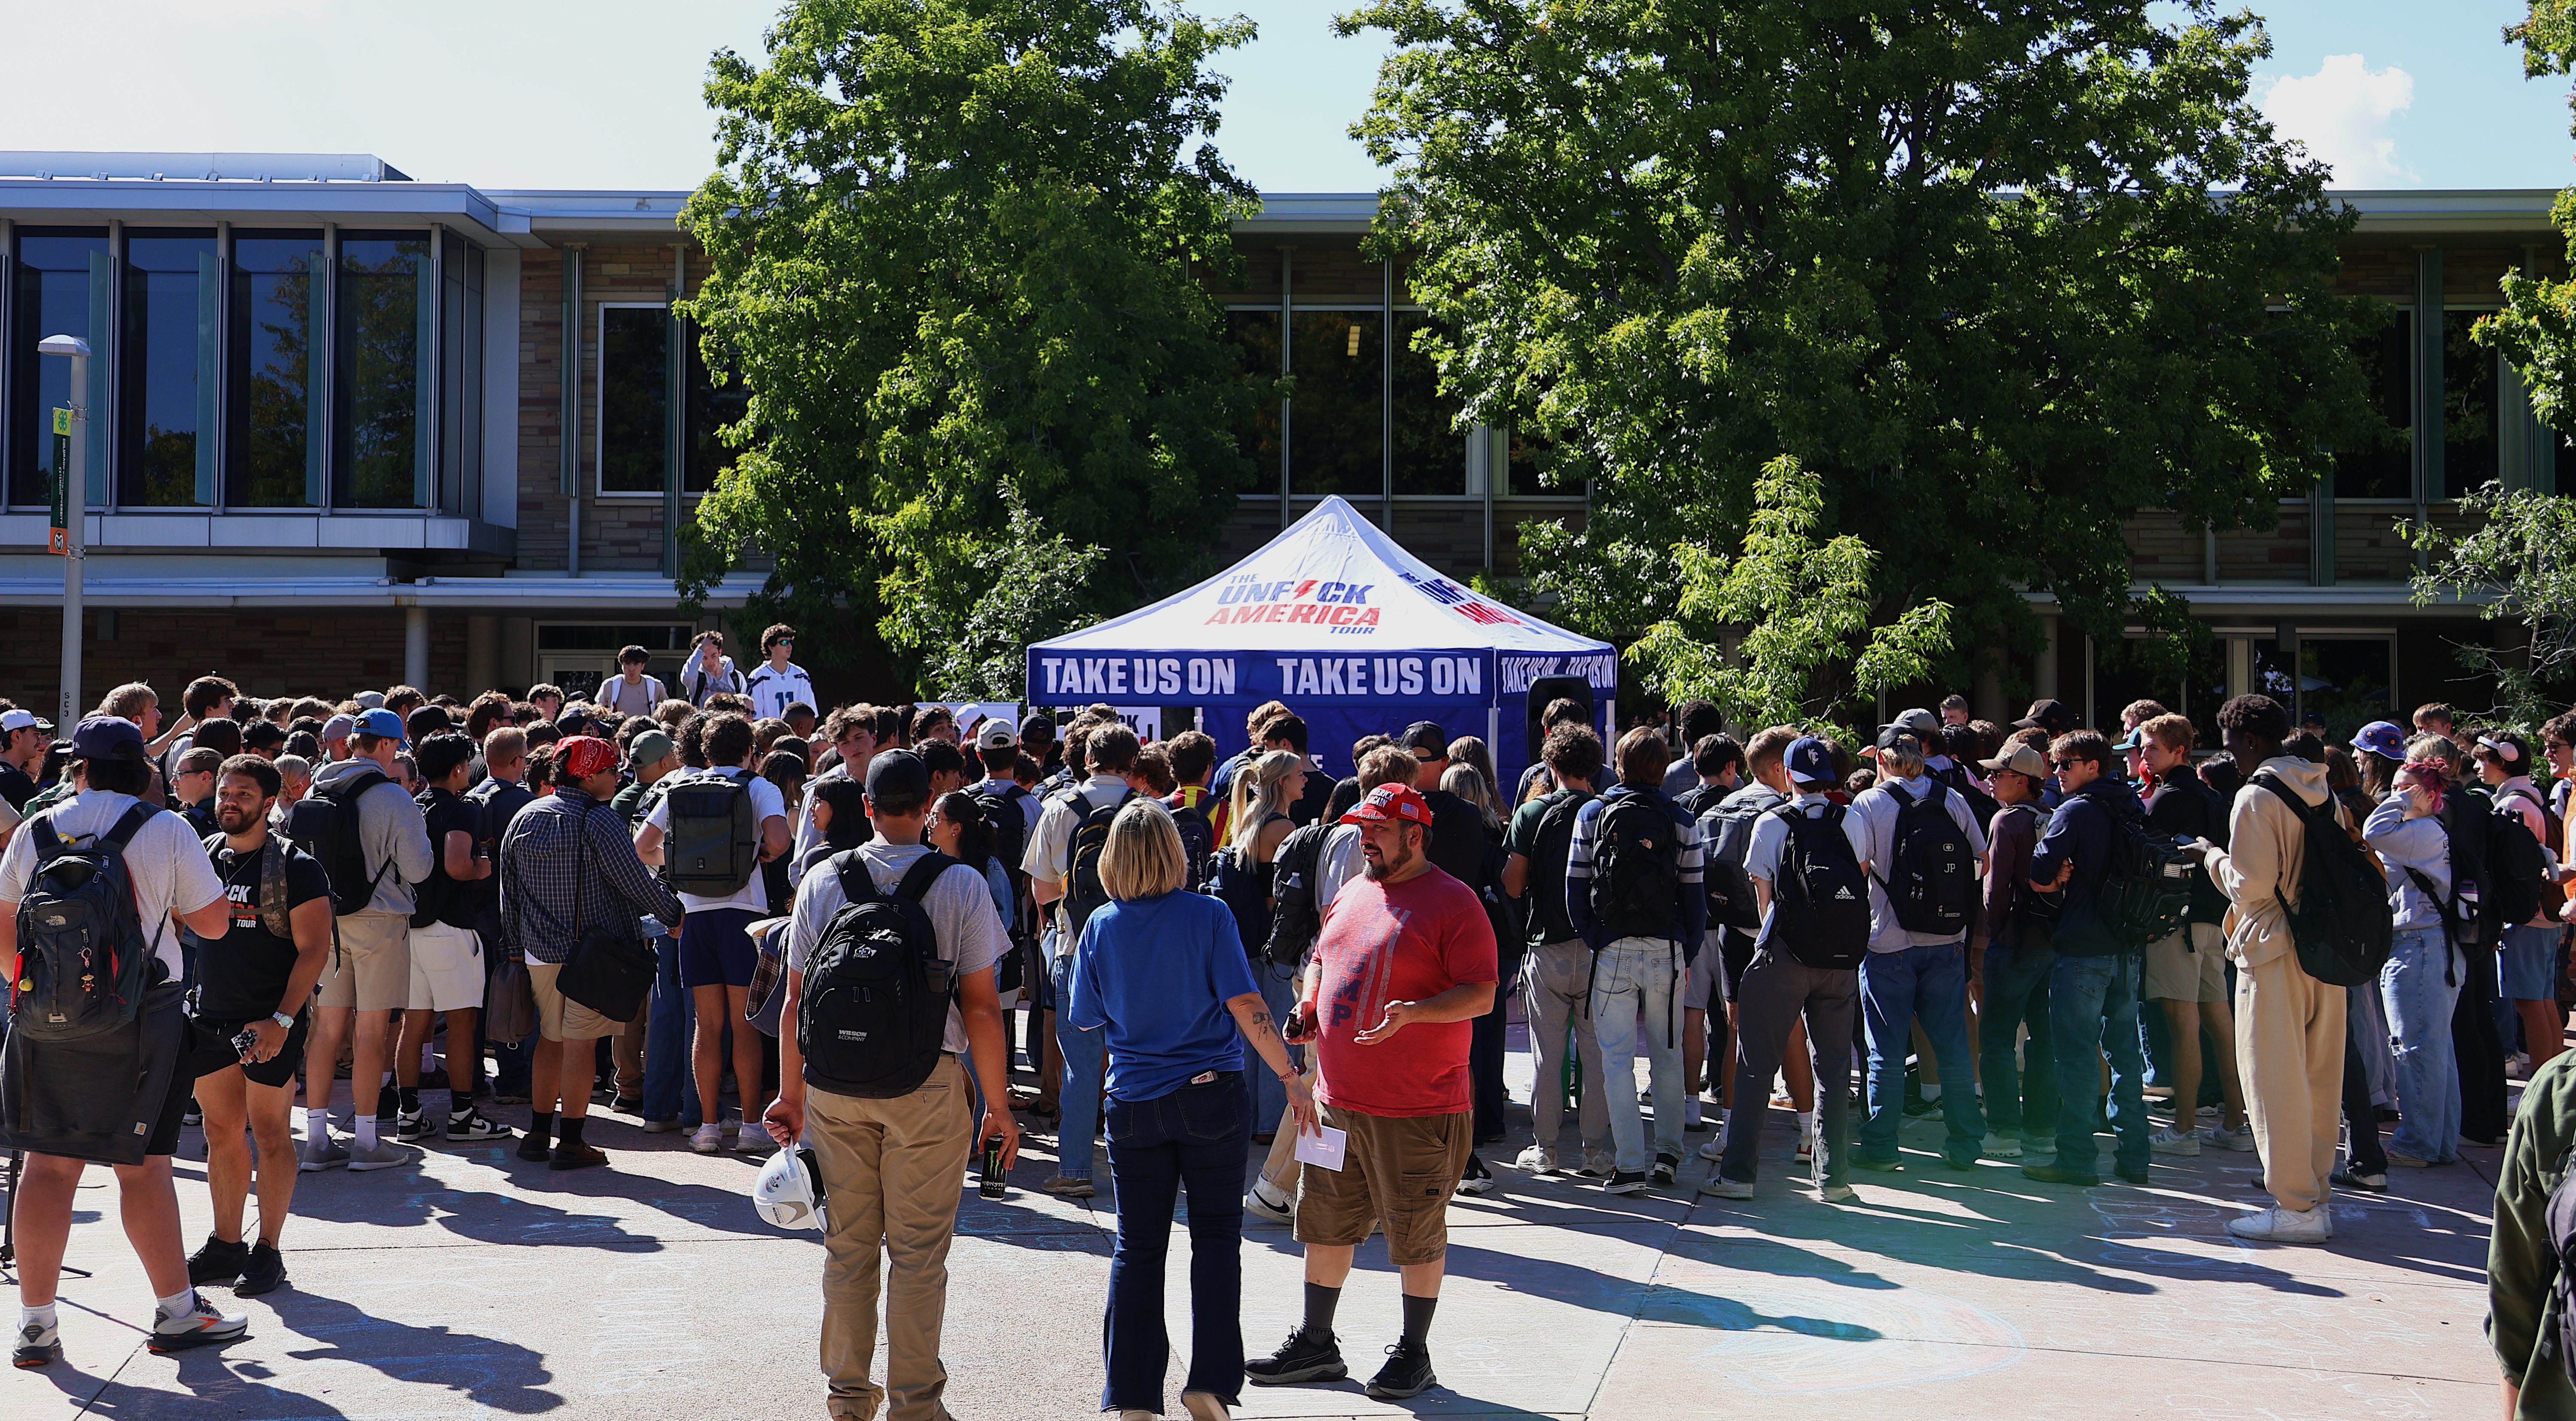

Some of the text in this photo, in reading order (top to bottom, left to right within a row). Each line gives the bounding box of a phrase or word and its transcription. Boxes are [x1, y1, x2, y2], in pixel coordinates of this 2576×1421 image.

[1231, 574, 1259, 584] THE
[1203, 604, 1380, 625] AMERICA
[1042, 658, 1235, 695] TAKE US ON
[1276, 657, 1481, 695] TAKE US ON
[1501, 657, 1529, 694] TAKE
[775, 691, 794, 719] 11
[1944, 863, 1956, 873] JP
[237, 919, 256, 928] TOUR
[1331, 903, 1393, 1027] TRUMP
[838, 1029, 867, 1038] WILSON
[772, 1207, 781, 1224] WILSON
